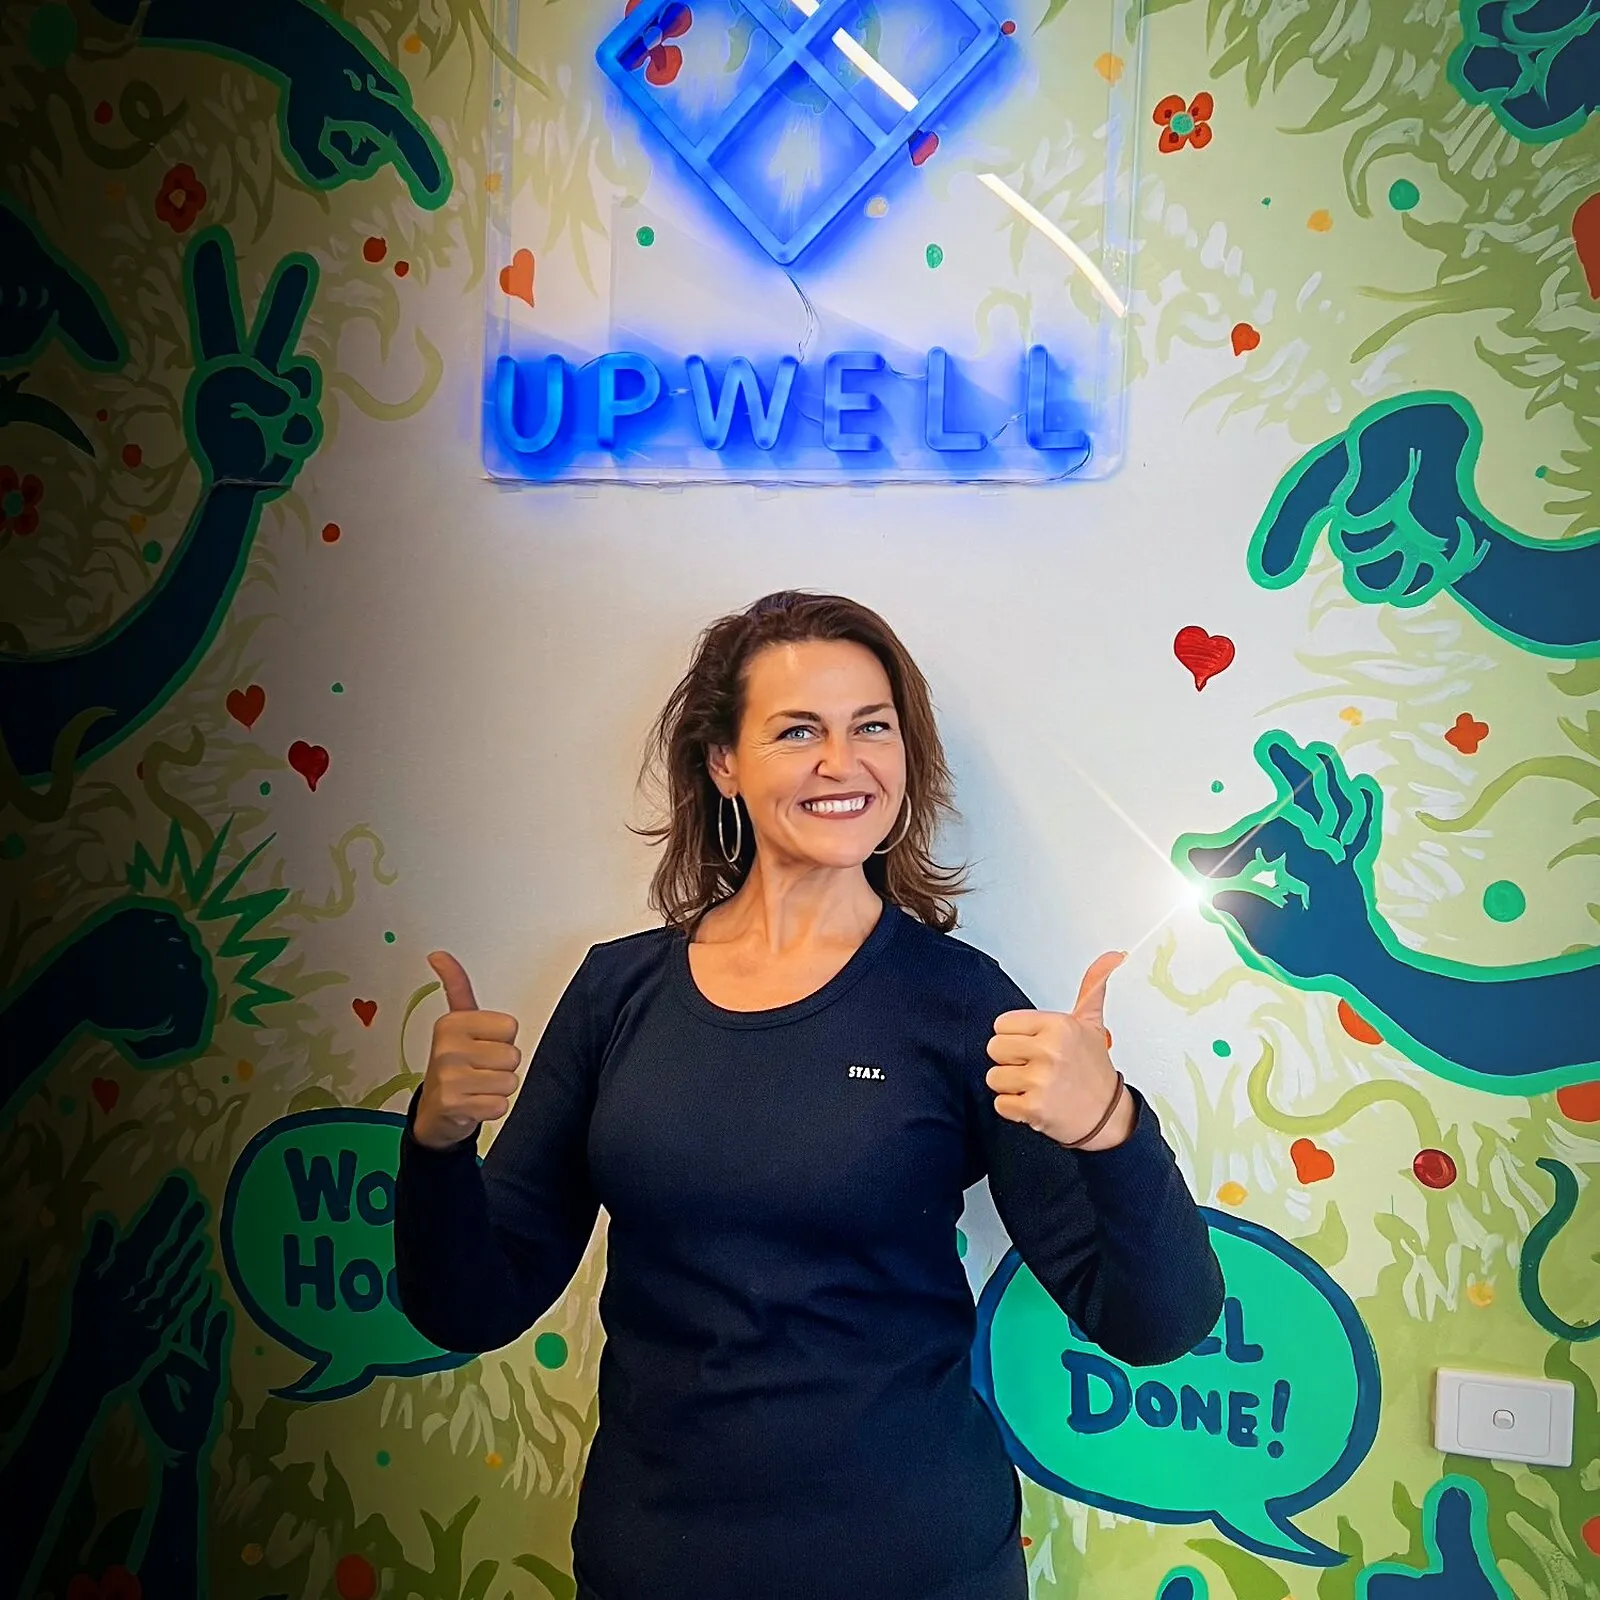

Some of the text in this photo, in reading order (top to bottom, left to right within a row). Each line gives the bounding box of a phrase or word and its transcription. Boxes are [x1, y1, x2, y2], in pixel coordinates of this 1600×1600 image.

[495, 344, 1092, 454] UPWELL
[848, 1065, 886, 1081] STAX.
[1060, 1348, 1291, 1459] DONE!
